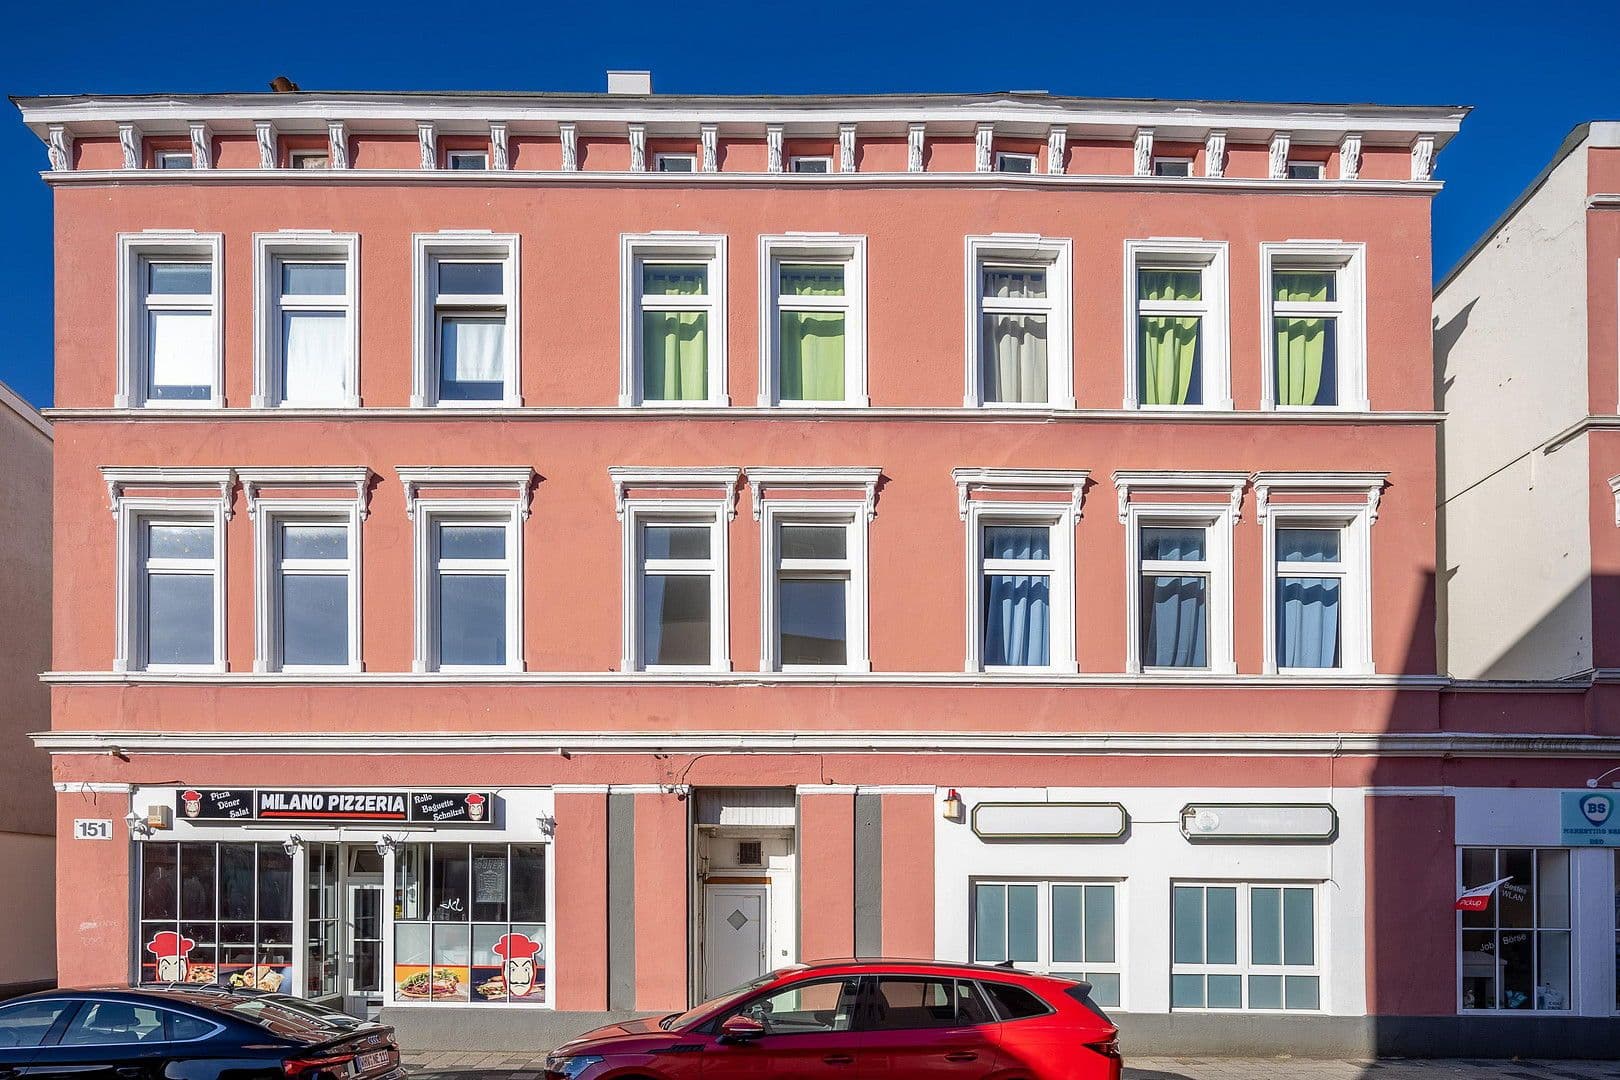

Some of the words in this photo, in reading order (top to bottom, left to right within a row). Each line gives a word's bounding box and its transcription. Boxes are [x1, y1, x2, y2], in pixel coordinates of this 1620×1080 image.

[210, 791, 230, 801] Pizza
[414, 794, 433, 804] Rollo
[217, 799, 240, 810] Döner
[261, 793, 323, 810] MILANO
[328, 794, 405, 812] PIZZERIA
[421, 799, 454, 813] Baguette
[229, 807, 250, 818] Salat
[433, 806, 465, 821] Schnitzel
[1587, 803, 1606, 814] BS
[79, 822, 107, 837] 151
[1502, 889, 1524, 903] WLAN
[1480, 941, 1495, 952] Job
